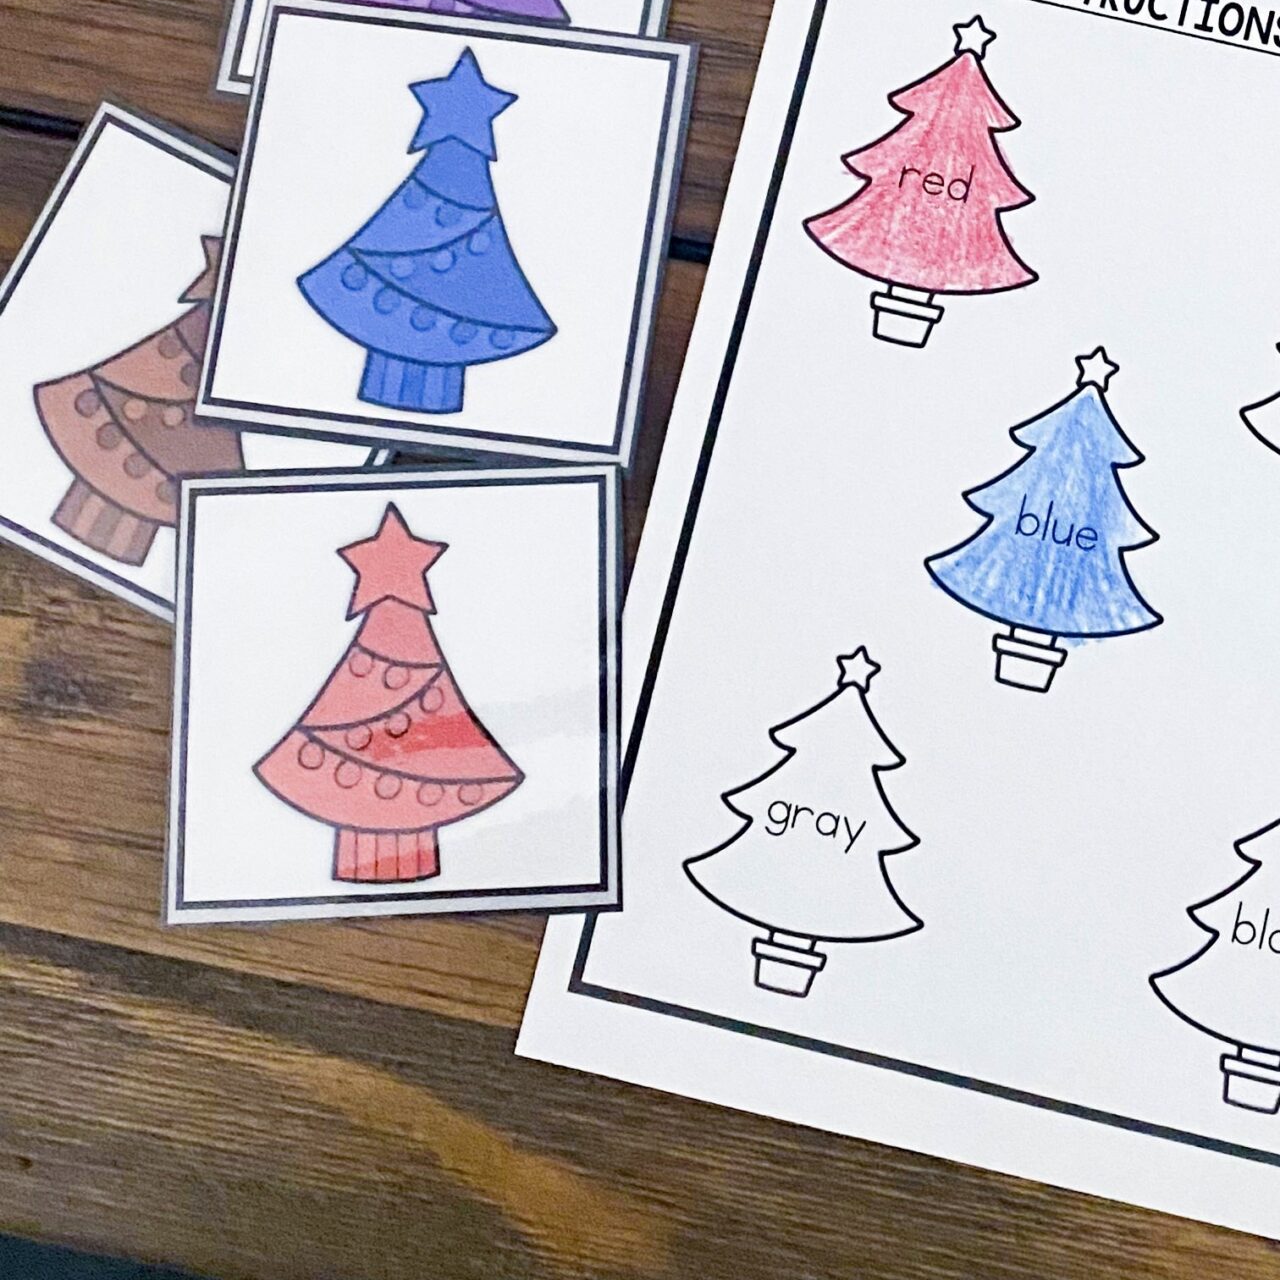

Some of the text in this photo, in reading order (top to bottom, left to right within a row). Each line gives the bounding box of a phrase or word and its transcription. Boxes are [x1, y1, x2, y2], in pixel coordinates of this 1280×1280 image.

[899, 164, 975, 204] red
[1014, 492, 1099, 553] blue
[764, 800, 867, 855] gray
